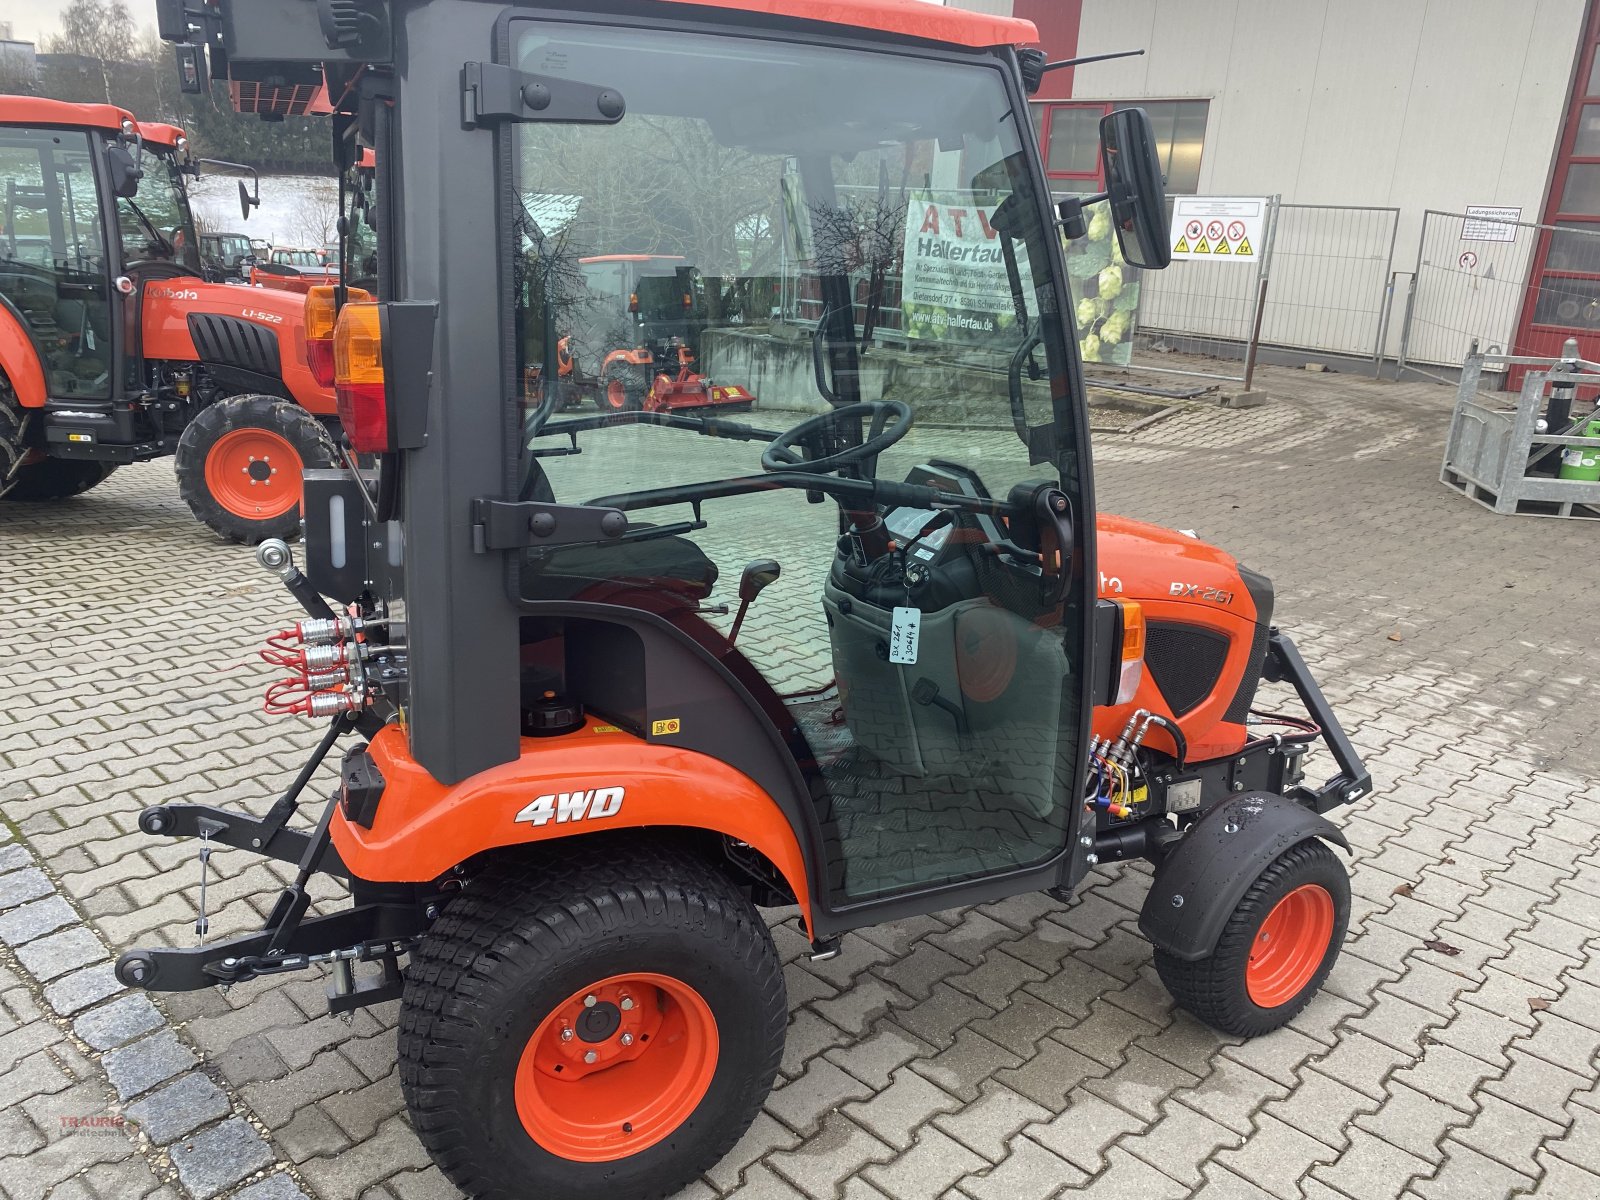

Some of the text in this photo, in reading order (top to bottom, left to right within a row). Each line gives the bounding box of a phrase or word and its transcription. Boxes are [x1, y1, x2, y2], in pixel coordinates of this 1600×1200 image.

[1469, 209, 1518, 217] Ladungssicherung
[917, 237, 1003, 263] Hallertau
[149, 287, 198, 300] Kubota
[913, 291, 943, 304] Dietersdorf
[943, 295, 954, 304] 37
[911, 311, 993, 331] www.atv-hallertau.de
[1169, 581, 1234, 605] BX-261
[893, 624, 903, 642] 261
[514, 785, 626, 828] 4WD
